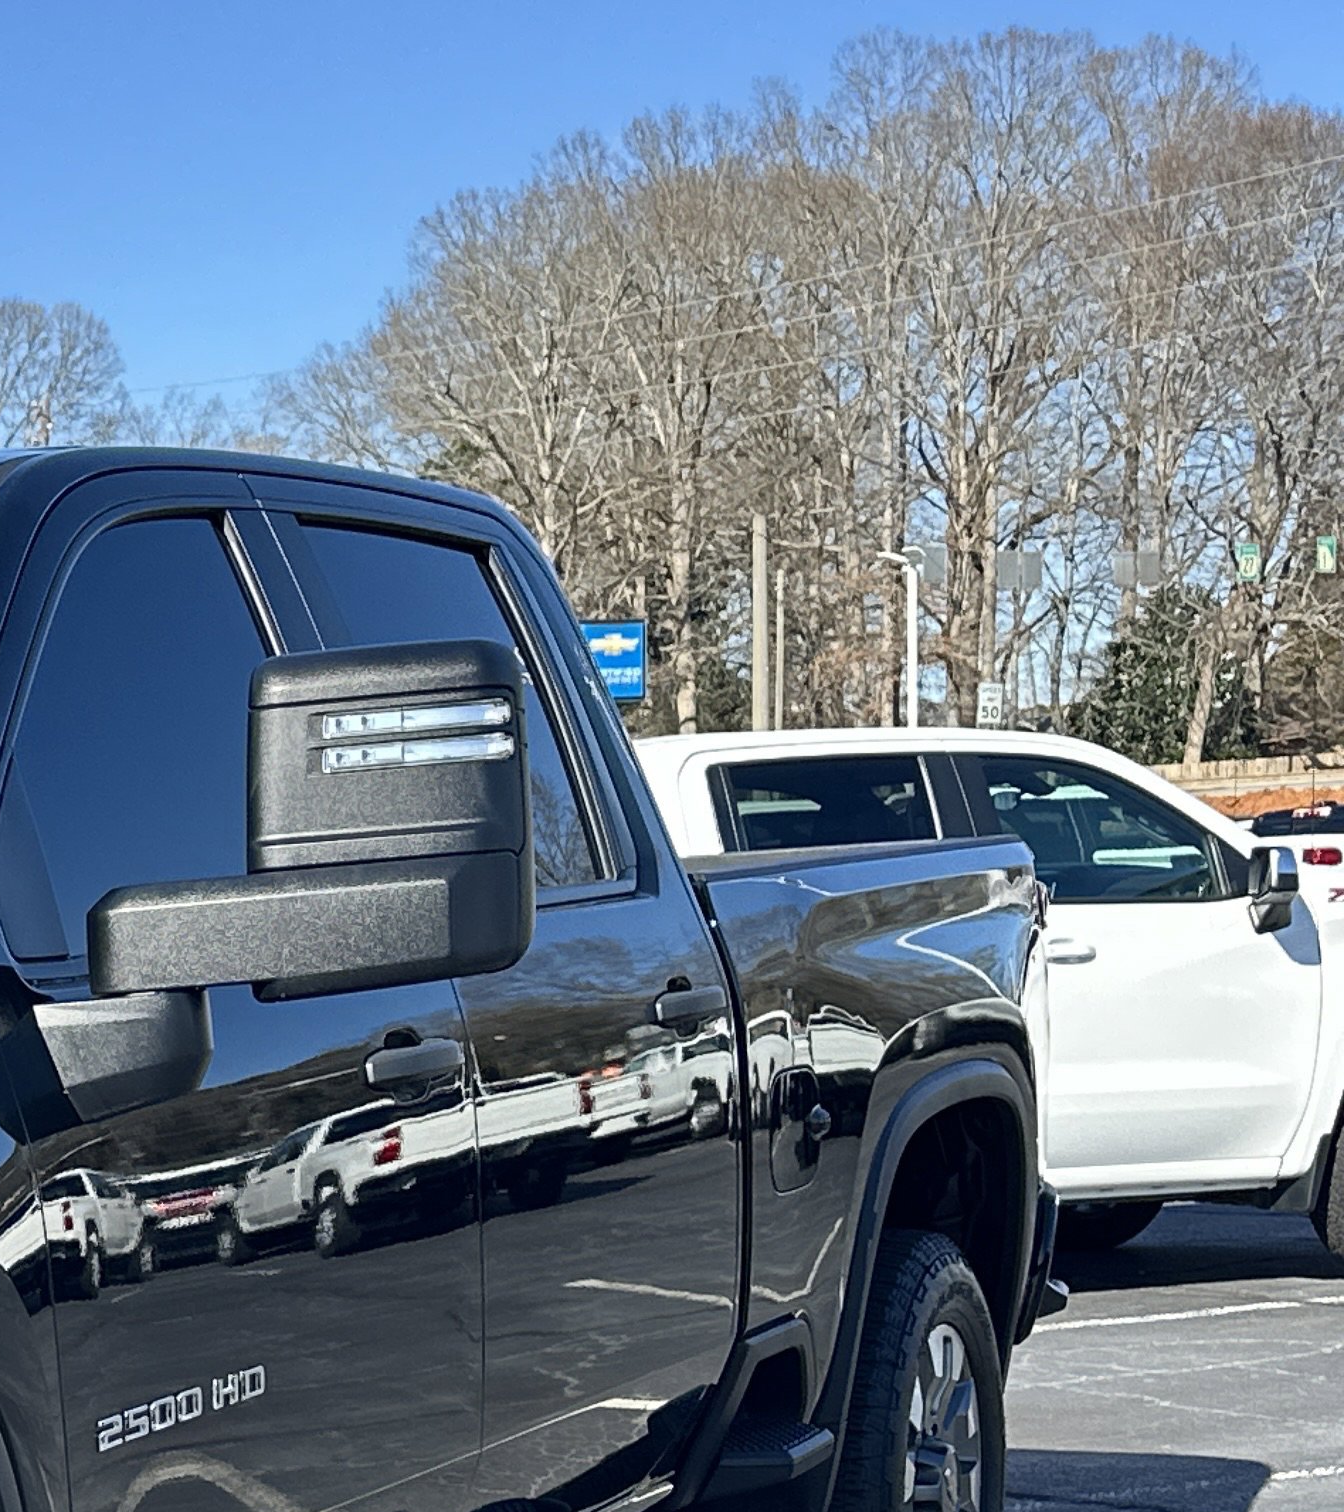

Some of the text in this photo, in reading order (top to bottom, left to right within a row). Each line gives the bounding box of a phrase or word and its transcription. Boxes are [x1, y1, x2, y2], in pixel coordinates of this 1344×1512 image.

[981, 705, 999, 719] 50
[98, 1365, 265, 1452] 2500 HD
